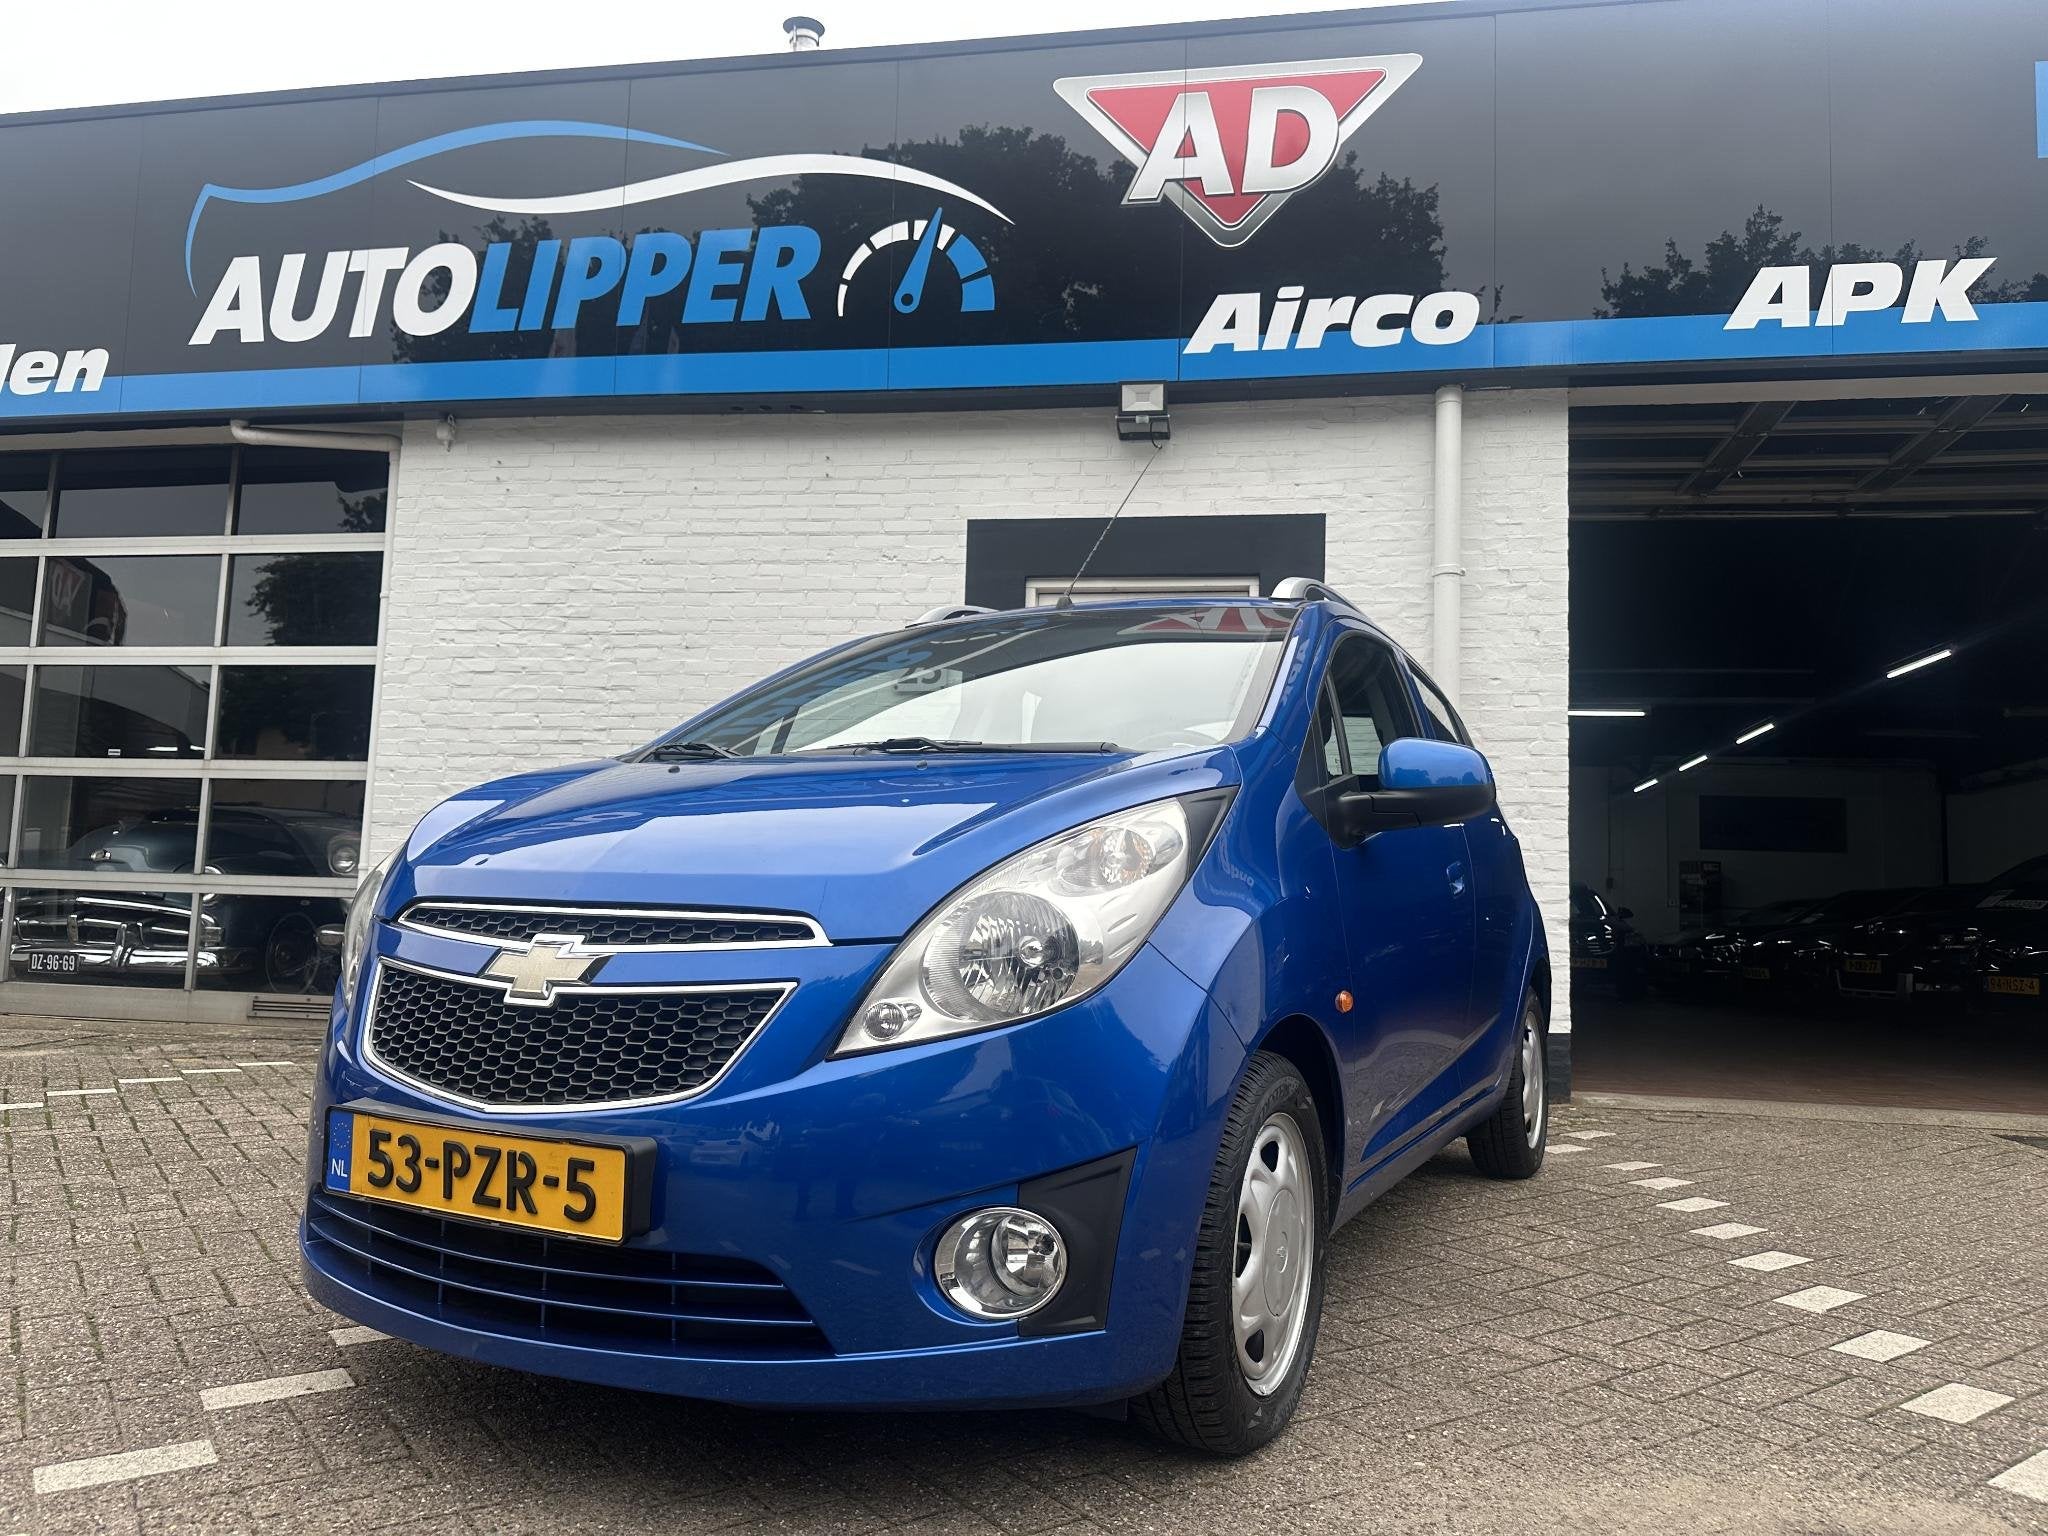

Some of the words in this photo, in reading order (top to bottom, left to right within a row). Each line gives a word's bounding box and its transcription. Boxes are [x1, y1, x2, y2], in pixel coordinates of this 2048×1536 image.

[1126, 85, 1340, 202] AD
[188, 225, 821, 345] AUTOLIPPER
[1182, 286, 1480, 354] Airco
[1723, 257, 1998, 330] APK
[31, 953, 75, 971] DZ-96-69
[331, 1157, 348, 1178] NL
[367, 1128, 597, 1223] 53-PZR-5
